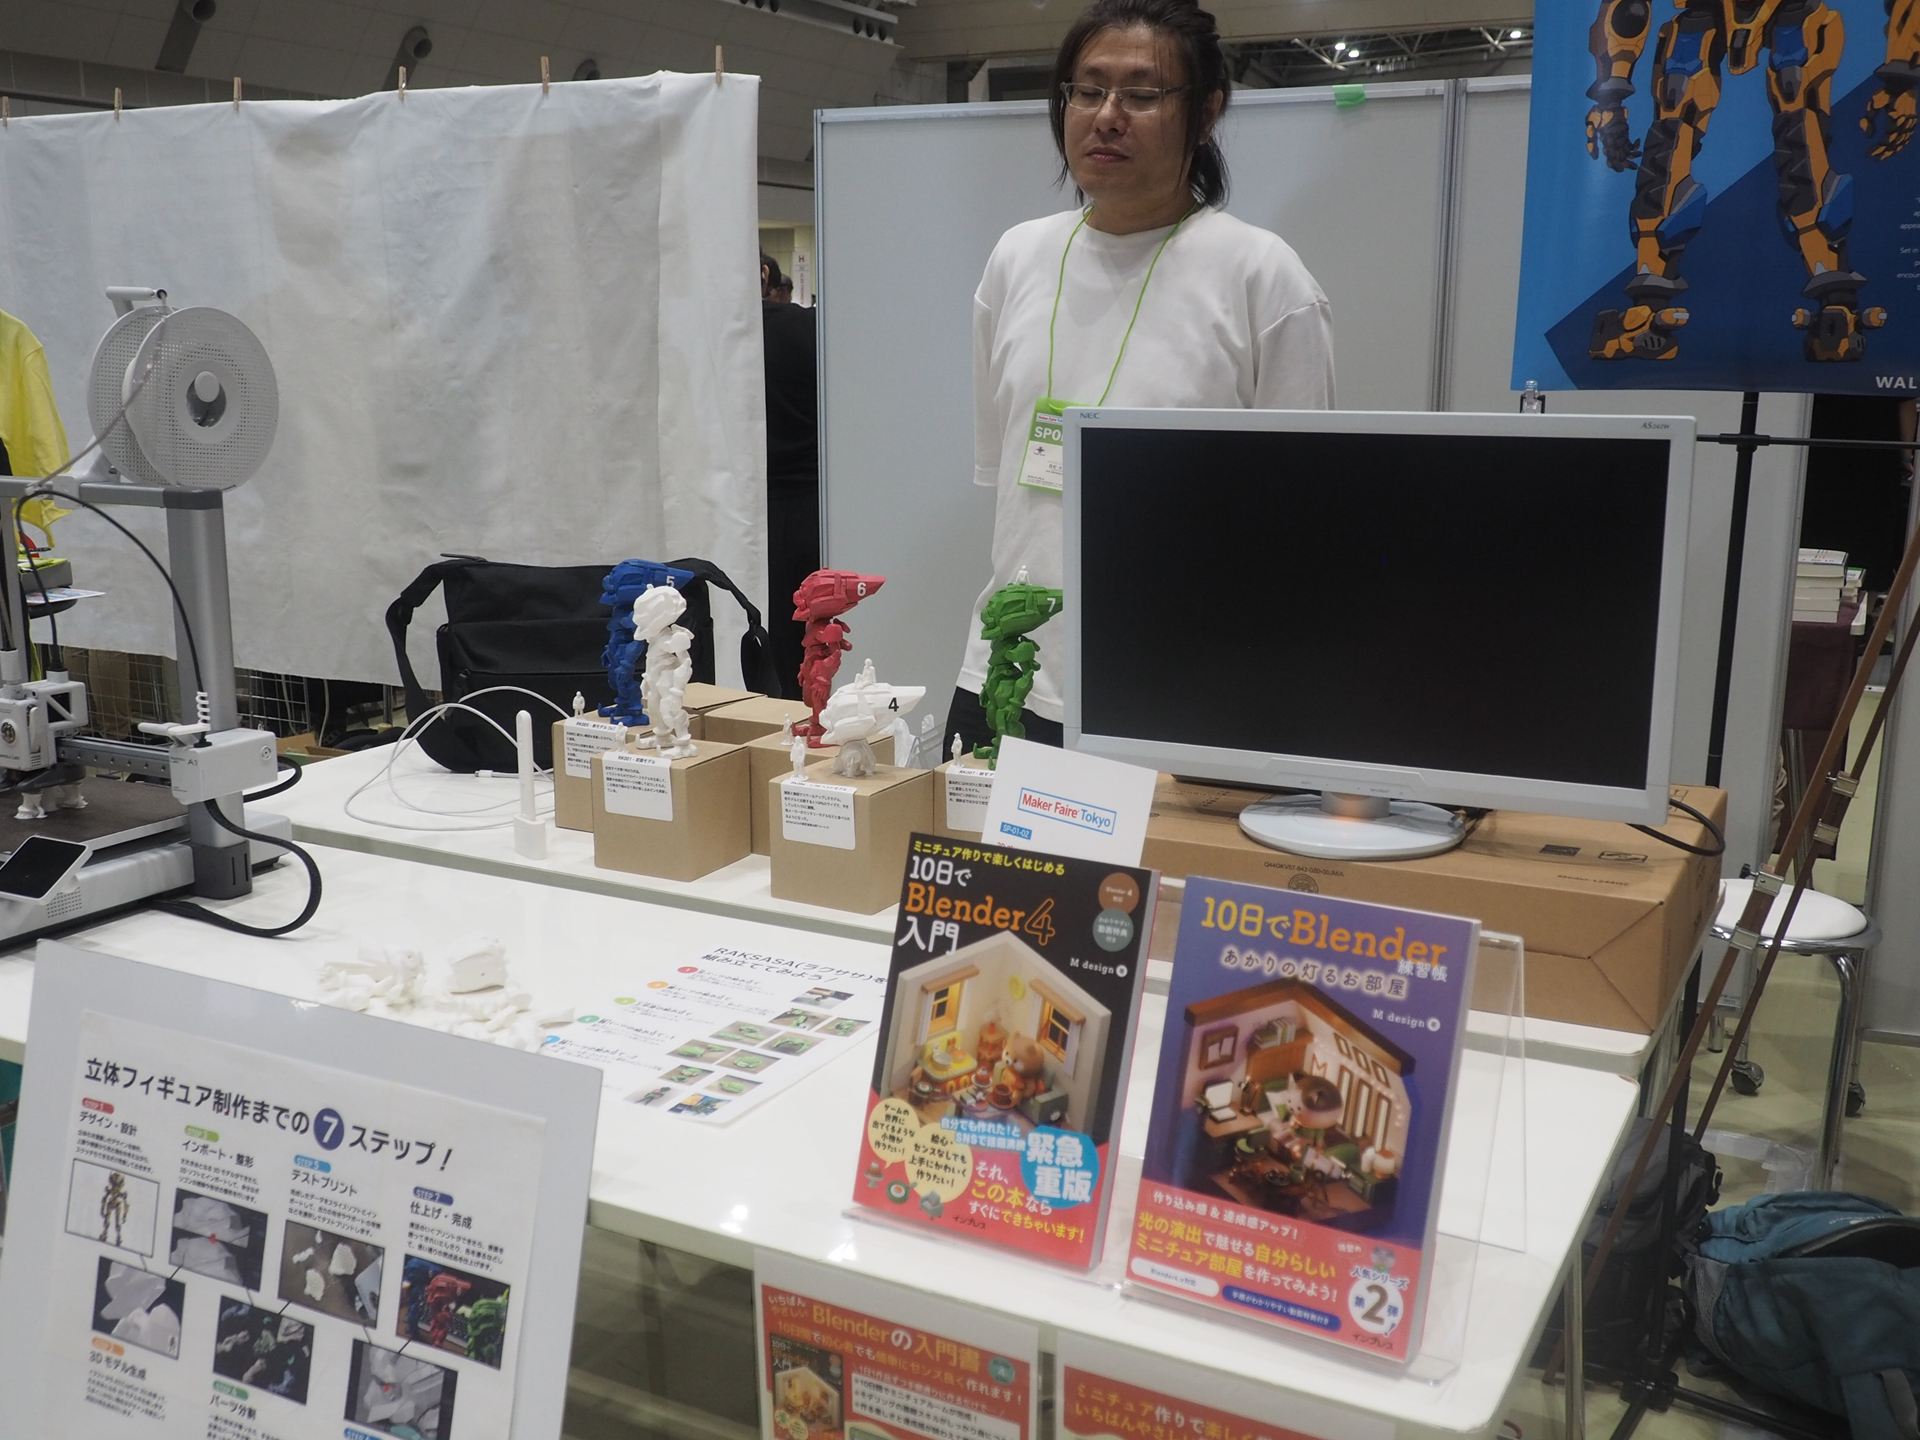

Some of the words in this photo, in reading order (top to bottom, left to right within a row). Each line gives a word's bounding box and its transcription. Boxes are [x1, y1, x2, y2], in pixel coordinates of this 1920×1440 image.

[1875, 376, 1917, 390] WAL
[1080, 412, 1100, 420] NEC
[666, 576, 675, 587] 5
[857, 582, 867, 597] 6
[1046, 597, 1056, 612] 7
[888, 697, 899, 712] 4
[1022, 793, 1052, 811] Maker
[1054, 802, 1079, 818] Faire
[1081, 809, 1111, 829] Tokyo
[910, 856, 972, 887] 10日で
[914, 840, 1065, 876] ミニチュア作りで楽しくはじめる
[898, 916, 960, 955] 入門
[1070, 957, 1081, 968] M
[1082, 960, 1115, 974] design
[1223, 948, 1406, 998] あかりの灯るお部屋
[1397, 959, 1448, 983] 練習帳
[1373, 1009, 1384, 1020] M
[1388, 1012, 1425, 1028] design
[884, 1104, 909, 1116] ゲームの
[1026, 1132, 1084, 1168] 緊急
[292, 1169, 358, 1197] テストプリント
[1033, 1166, 1092, 1203] 重版
[972, 1180, 1052, 1216] この本なら
[410, 1202, 472, 1230] 仕上げ・完成
[969, 1201, 1085, 1243] すぐにできちゃいます!
[1138, 1211, 1336, 1279] 光の演出で魅せる自分らしい
[1136, 1233, 1338, 1302] ミニチュア部屋を作ってみよう!
[1351, 1266, 1409, 1289] 人気シリーズ
